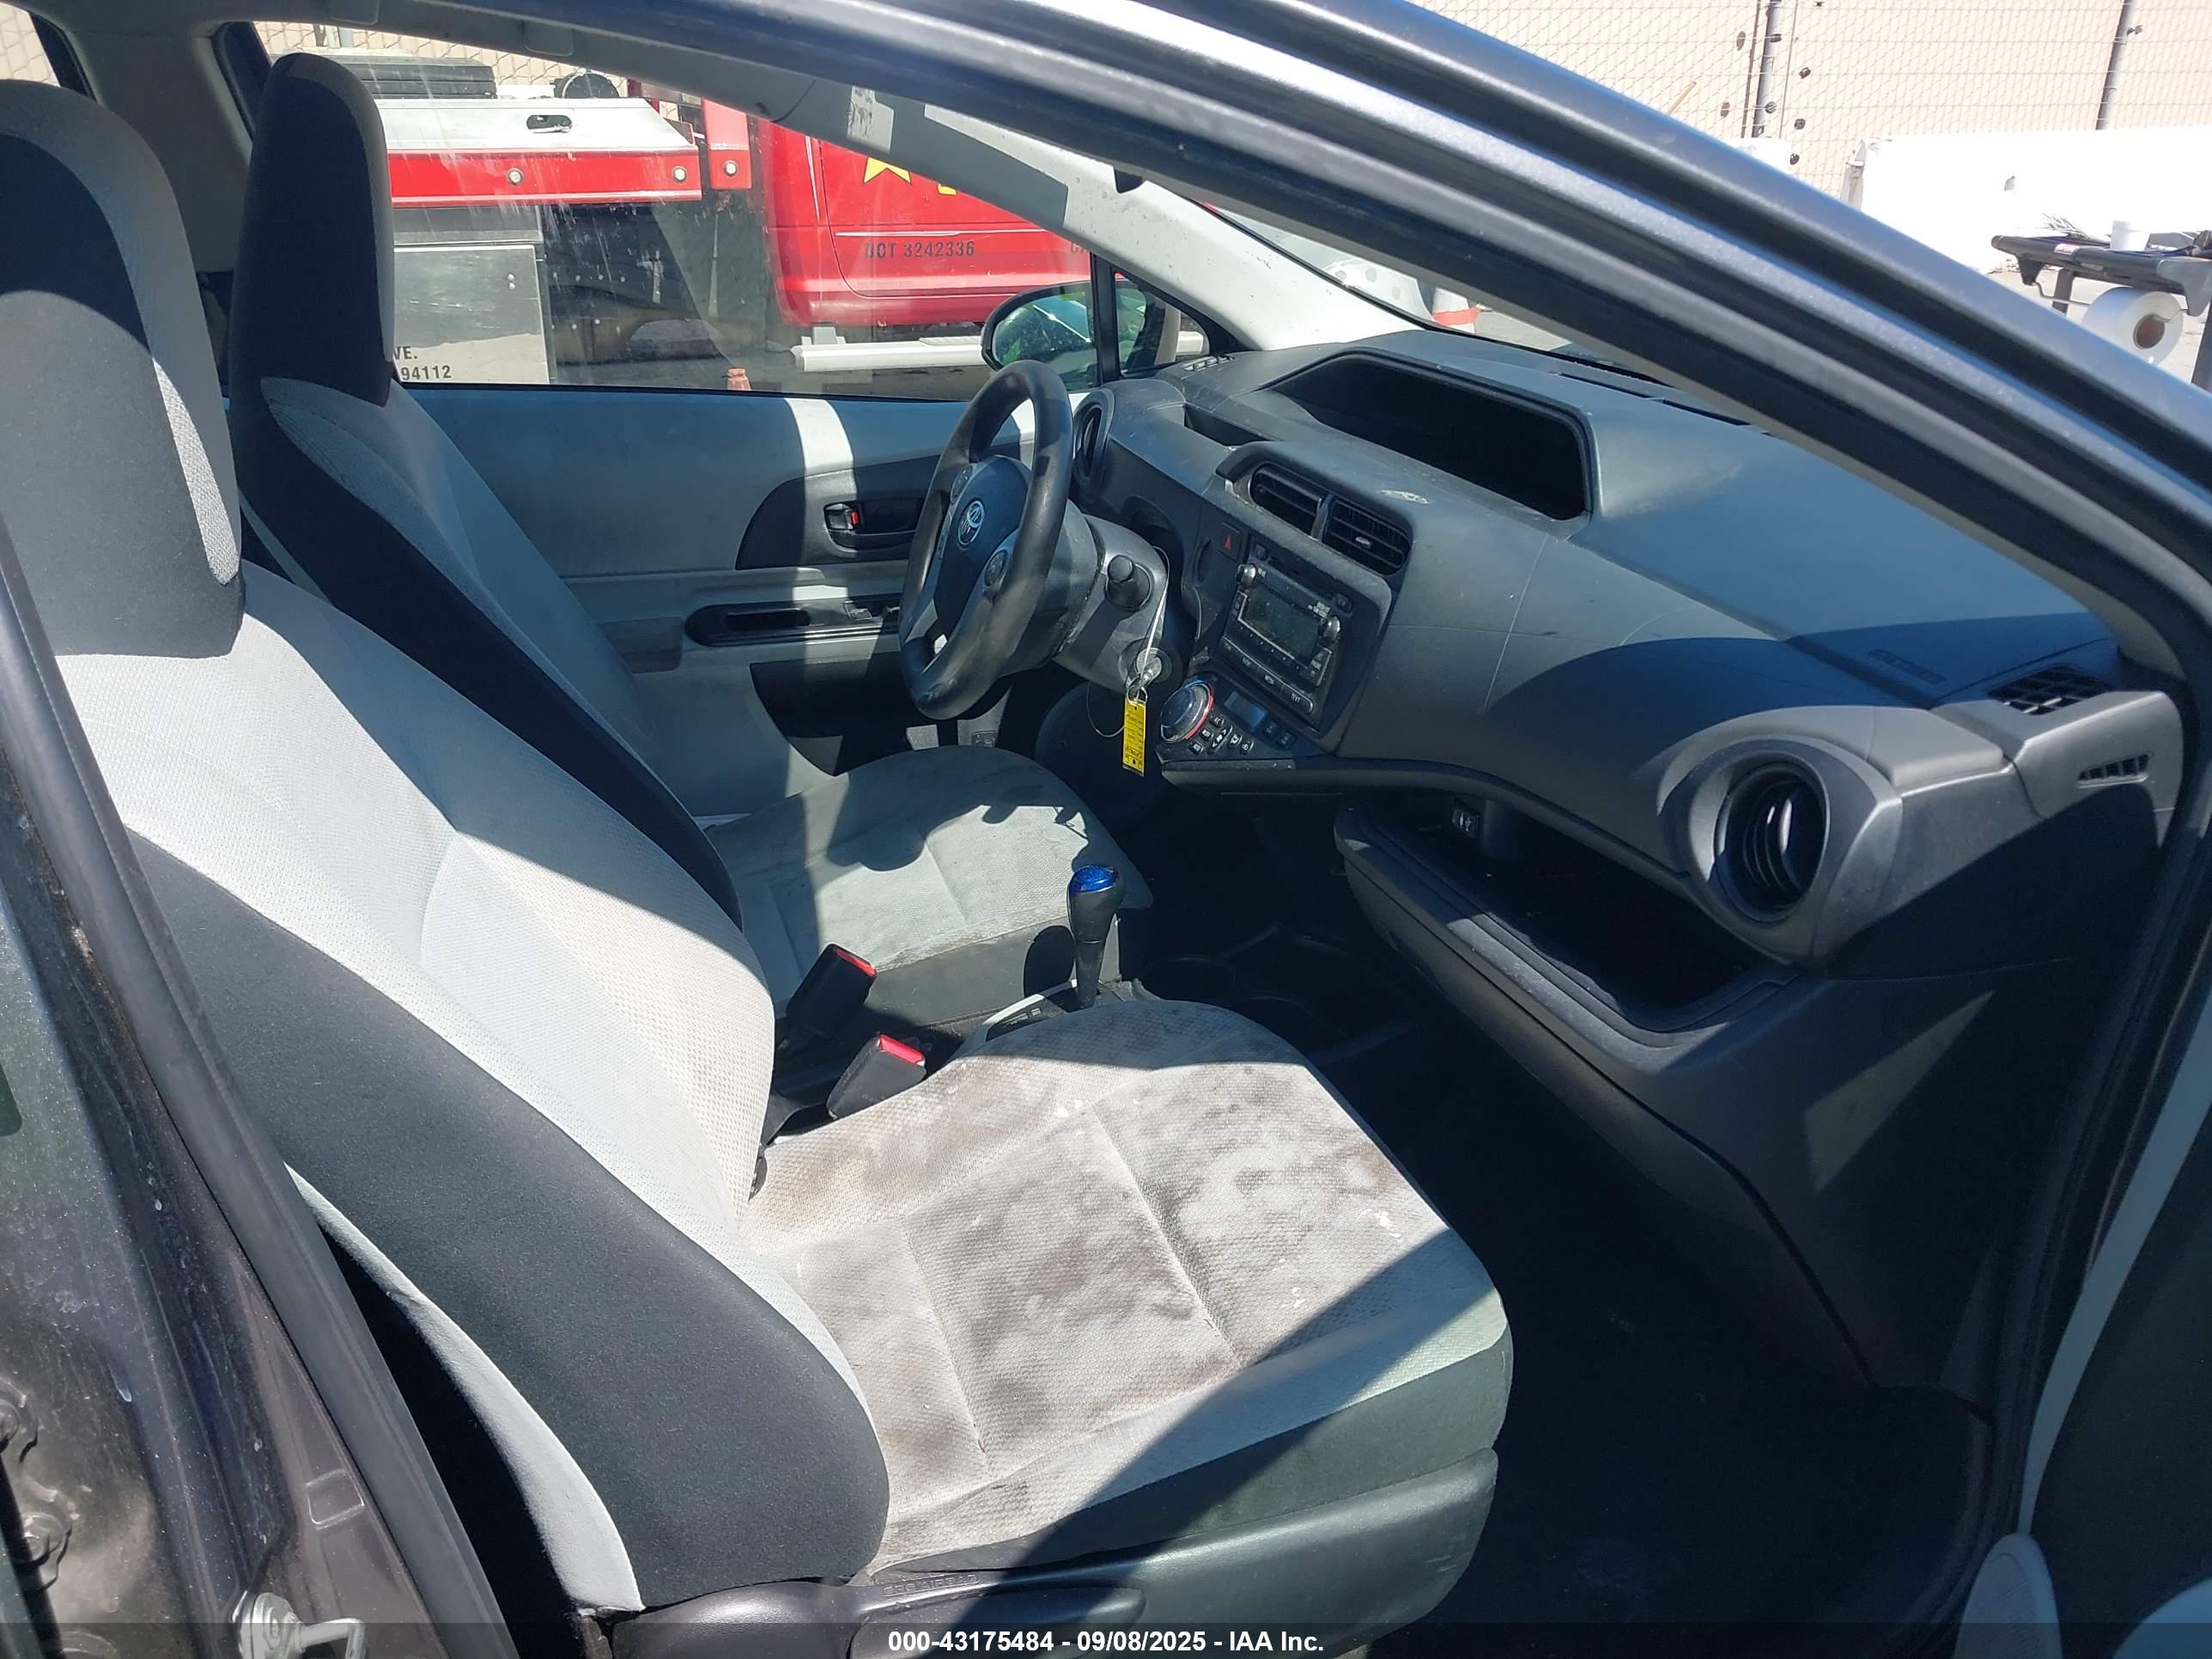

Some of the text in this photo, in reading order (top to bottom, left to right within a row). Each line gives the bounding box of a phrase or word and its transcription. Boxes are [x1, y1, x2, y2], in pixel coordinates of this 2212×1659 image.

[866, 241, 975, 258] DOT 3242336
[401, 365, 452, 380] 94112
